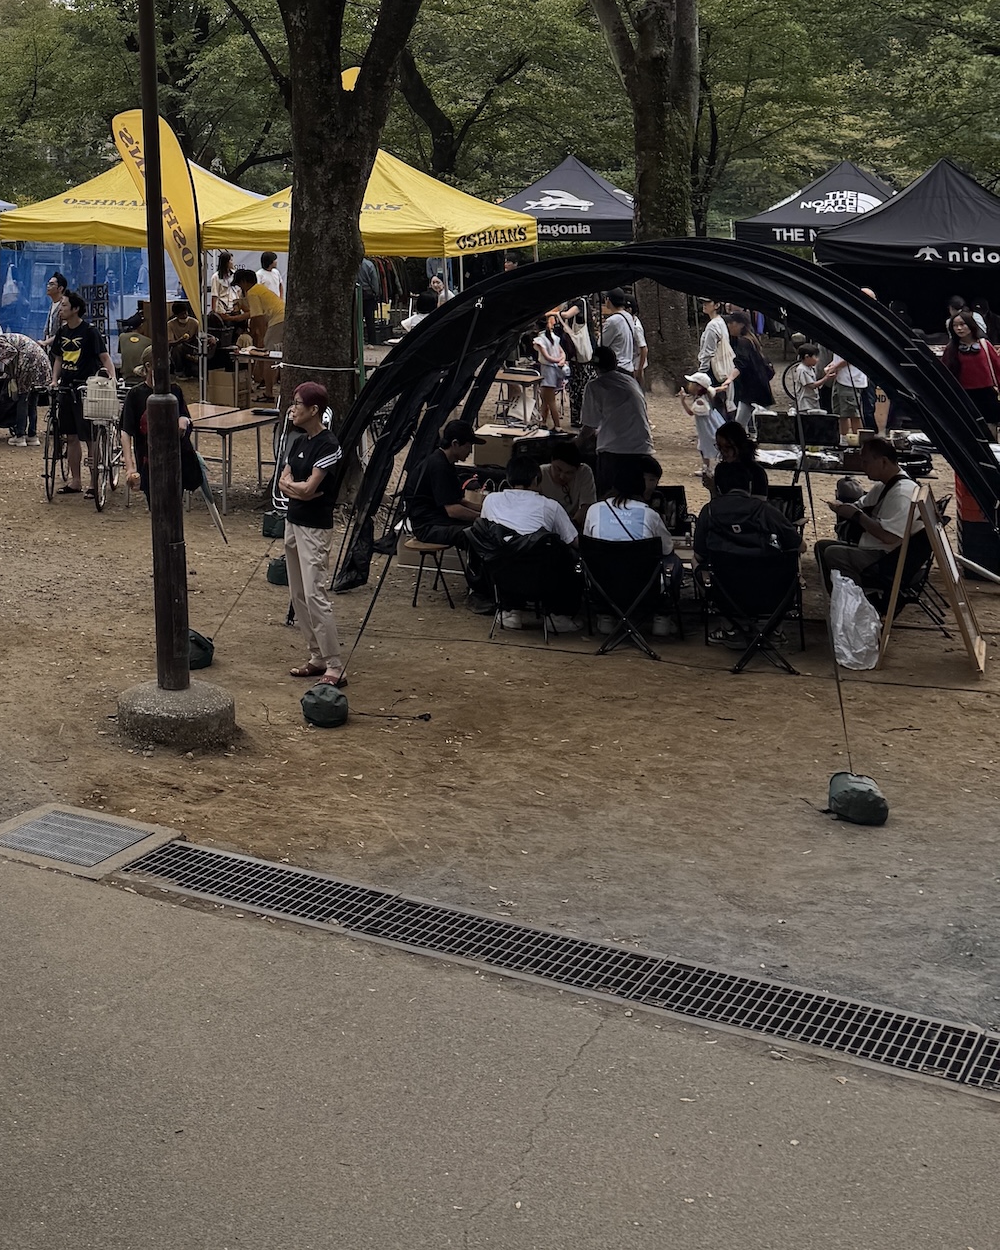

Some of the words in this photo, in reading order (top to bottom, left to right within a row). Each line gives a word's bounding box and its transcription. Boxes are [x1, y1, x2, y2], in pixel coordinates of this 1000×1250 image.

[825, 190, 857, 200] THE
[800, 198, 857, 209] NORTH
[815, 205, 857, 214] FACE
[456, 224, 527, 250] OSHMAN'S
[772, 228, 805, 241] THE
